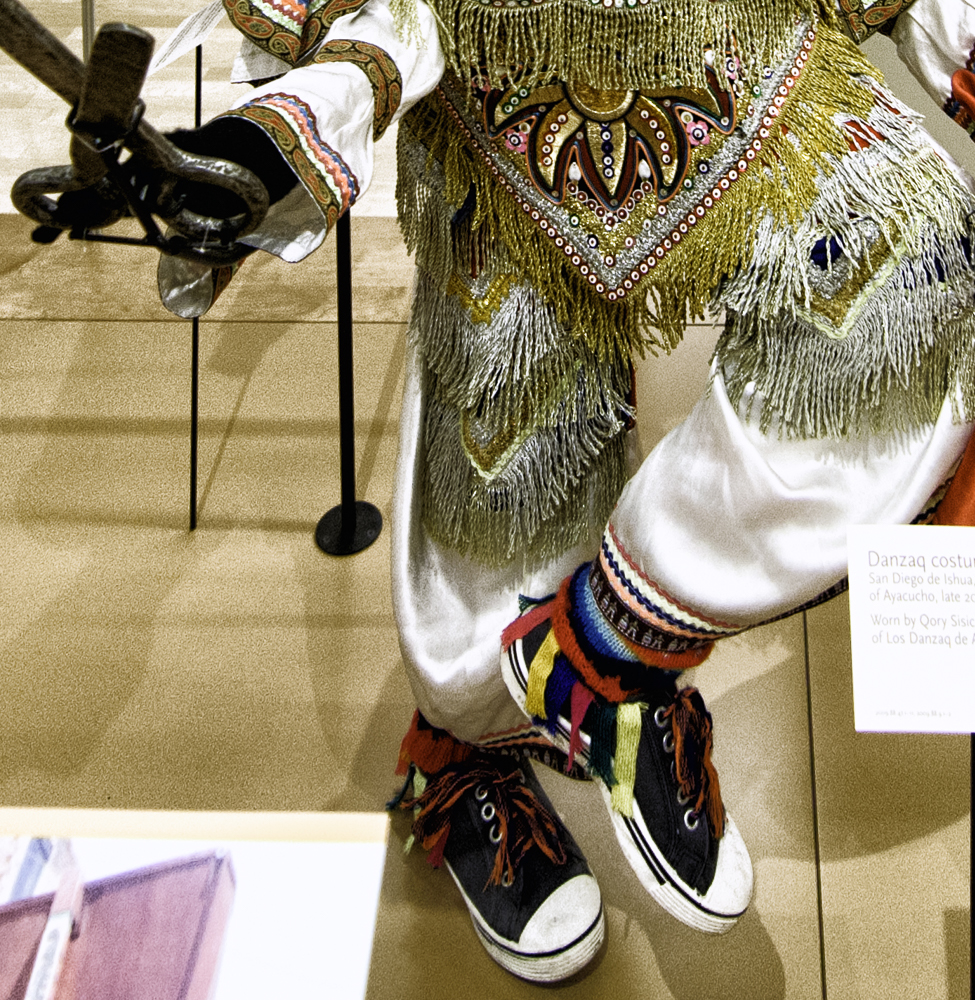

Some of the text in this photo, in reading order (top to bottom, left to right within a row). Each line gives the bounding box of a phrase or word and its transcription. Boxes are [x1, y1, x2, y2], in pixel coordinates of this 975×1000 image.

[868, 551, 926, 572] Danzaq
[869, 572, 888, 584] San
[893, 572, 924, 587] Diego
[927, 573, 940, 585] de
[944, 573, 975, 586] Ishua,
[870, 589, 880, 601] of
[883, 590, 938, 604] Ayacucho,
[941, 590, 960, 602] late
[870, 614, 900, 626] Worn
[904, 614, 916, 629] by
[920, 614, 947, 629] Qory
[872, 631, 882, 643] of
[887, 632, 905, 644] Los
[909, 632, 951, 648] Danzaq
[955, 632, 968, 645] de
